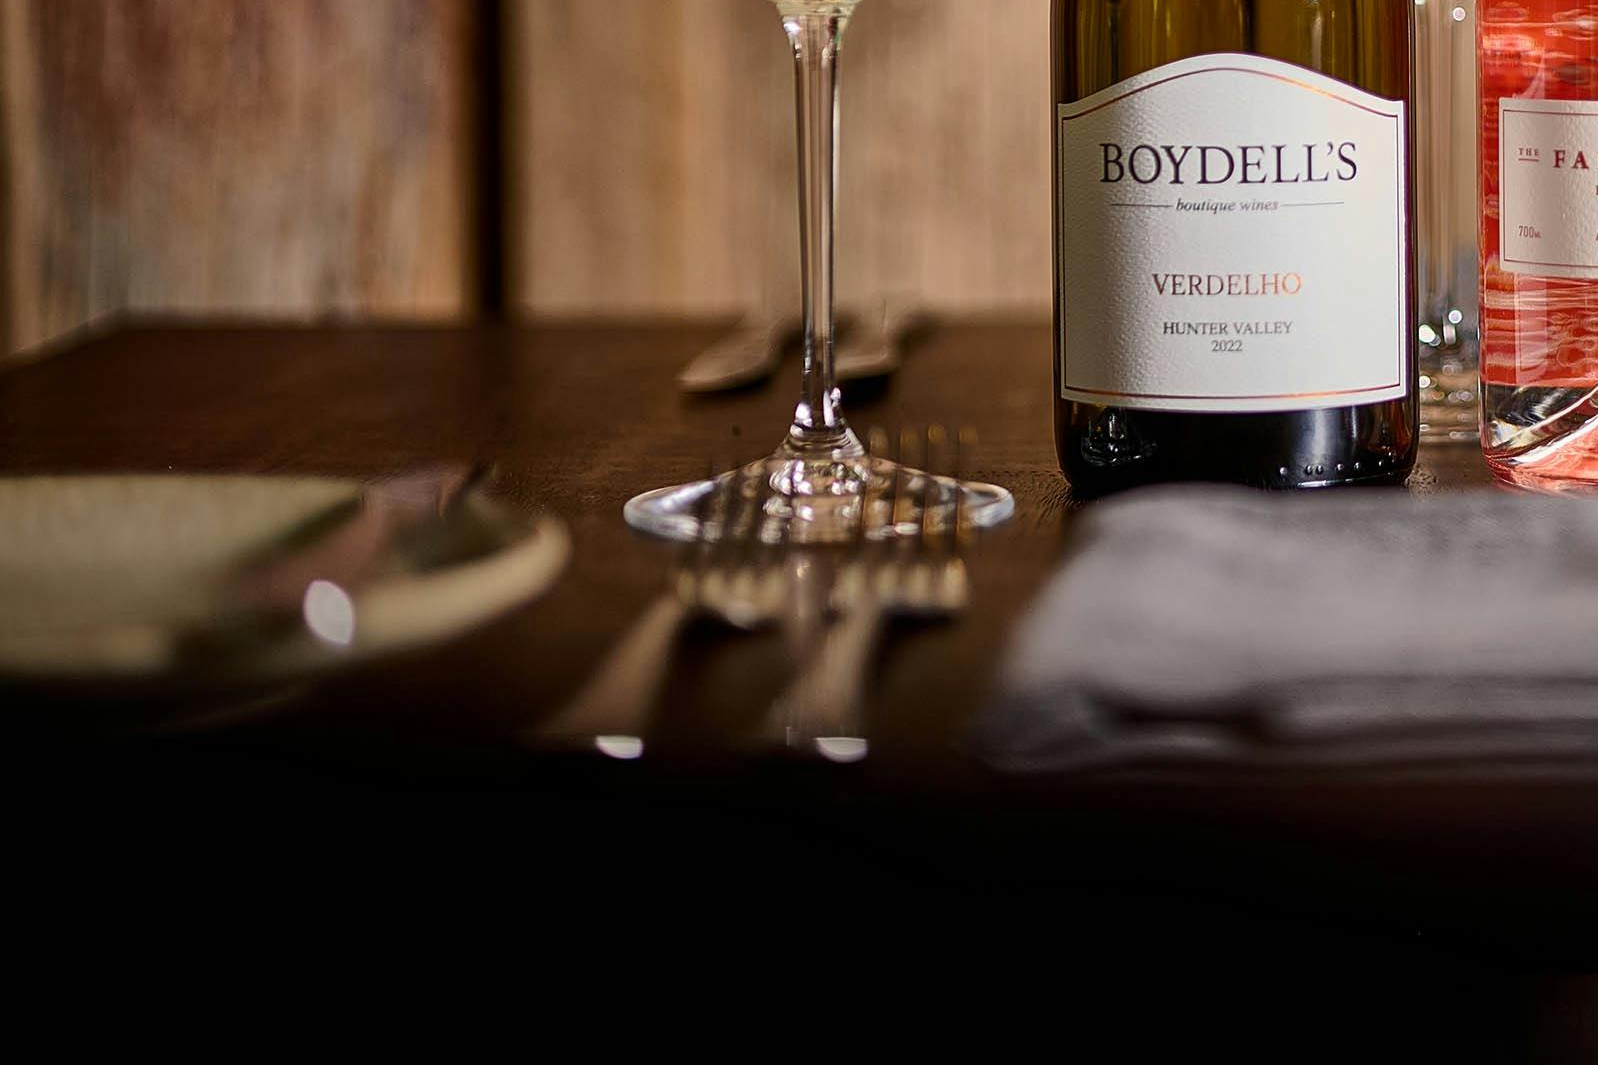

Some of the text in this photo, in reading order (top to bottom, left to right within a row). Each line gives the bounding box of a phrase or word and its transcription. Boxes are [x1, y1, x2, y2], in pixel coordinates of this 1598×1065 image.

[1518, 147, 1540, 157] THE
[1098, 141, 1359, 185] BOYDELL'S
[1175, 198, 1279, 215] boutique wines
[1151, 271, 1303, 296] VERDELHO
[1162, 320, 1294, 336] HUNTER VALLEY
[1211, 339, 1244, 353] 2022
